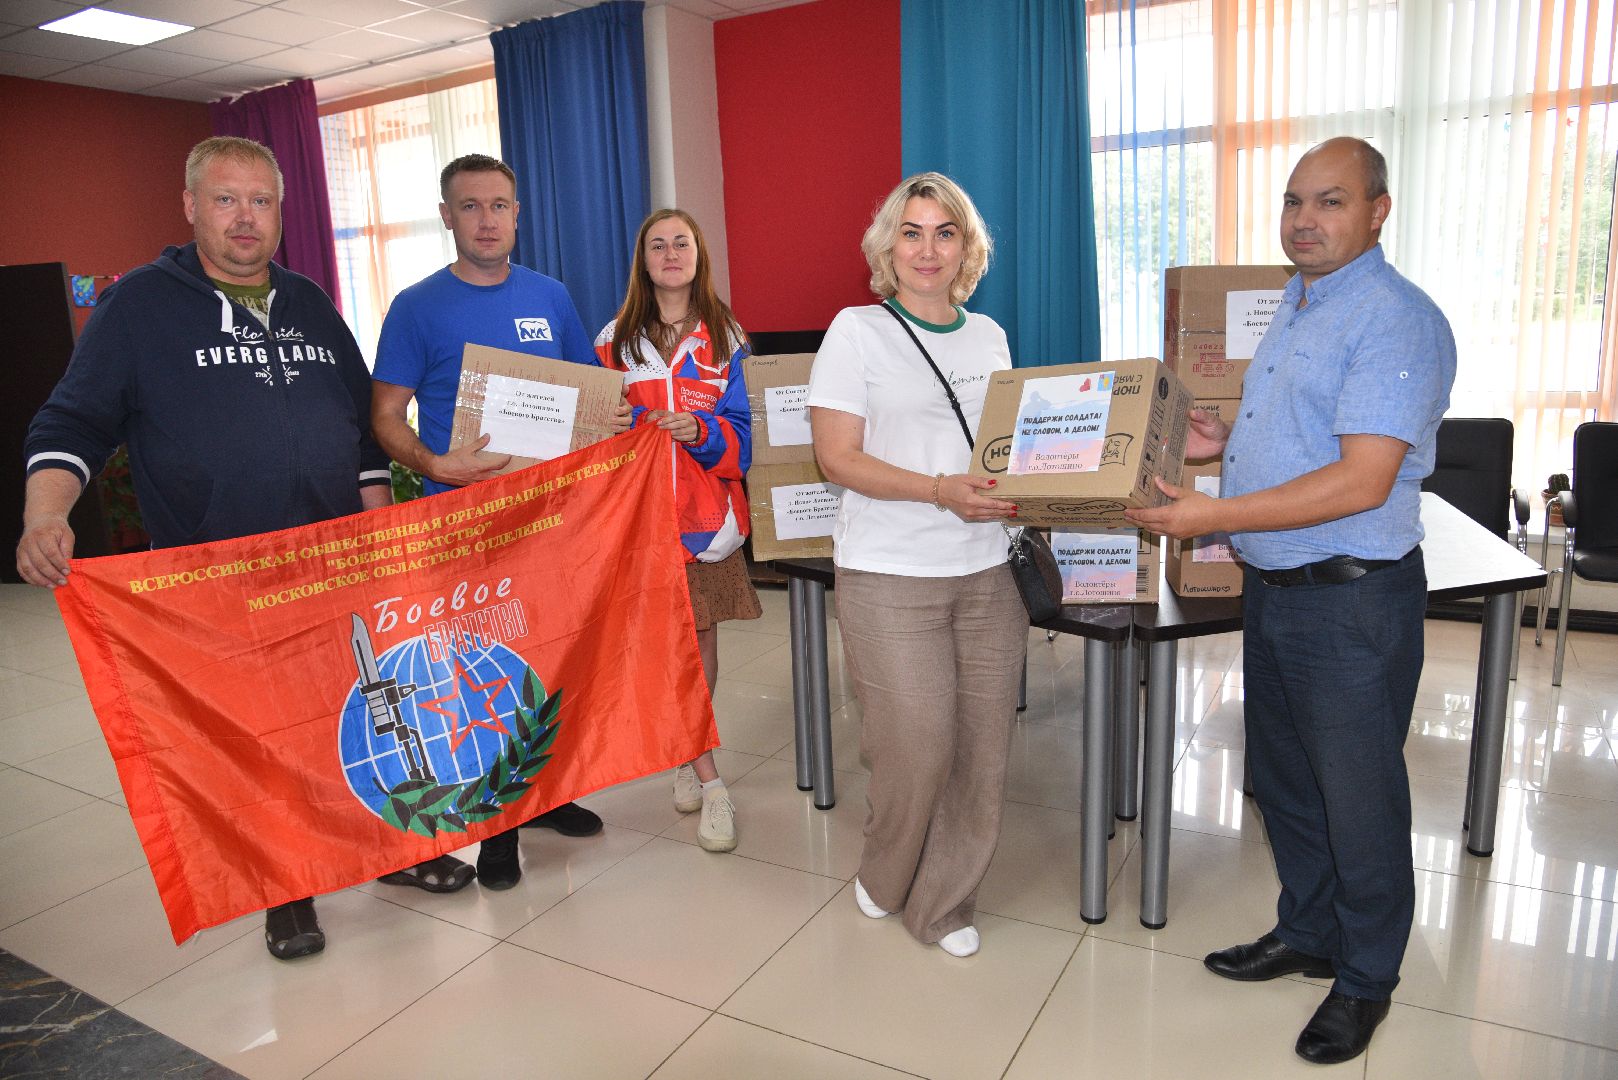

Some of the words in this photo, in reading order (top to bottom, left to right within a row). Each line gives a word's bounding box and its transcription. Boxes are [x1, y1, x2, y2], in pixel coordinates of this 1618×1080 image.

[1112, 385, 1141, 396] ПЮР
[1023, 415, 1063, 425] ПОДДЕРЖИ
[1064, 413, 1103, 421] СОЛДАТА!
[1071, 424, 1100, 434] ДЕЛОМ!
[128, 550, 297, 594] ВСЕРОССИЙСКАЯ
[299, 516, 442, 560] ОБЩЕСТВЕННАЯ
[445, 479, 553, 526] ОРГАНИЗАЦИЯ
[556, 449, 637, 489] ВЕТЕРАНОВ
[1057, 548, 1095, 556] ПОДДЕРЖИ
[247, 570, 370, 613] МОСКОВСКОЕ
[373, 547, 472, 578] ОБЛАСТНОЕ
[474, 513, 564, 552] ОТДЕЛЕНИЕ
[1105, 558, 1131, 566] ДЕЛОМ!
[373, 577, 512, 633] Боевое
[423, 598, 529, 663] БРАТСТВО
